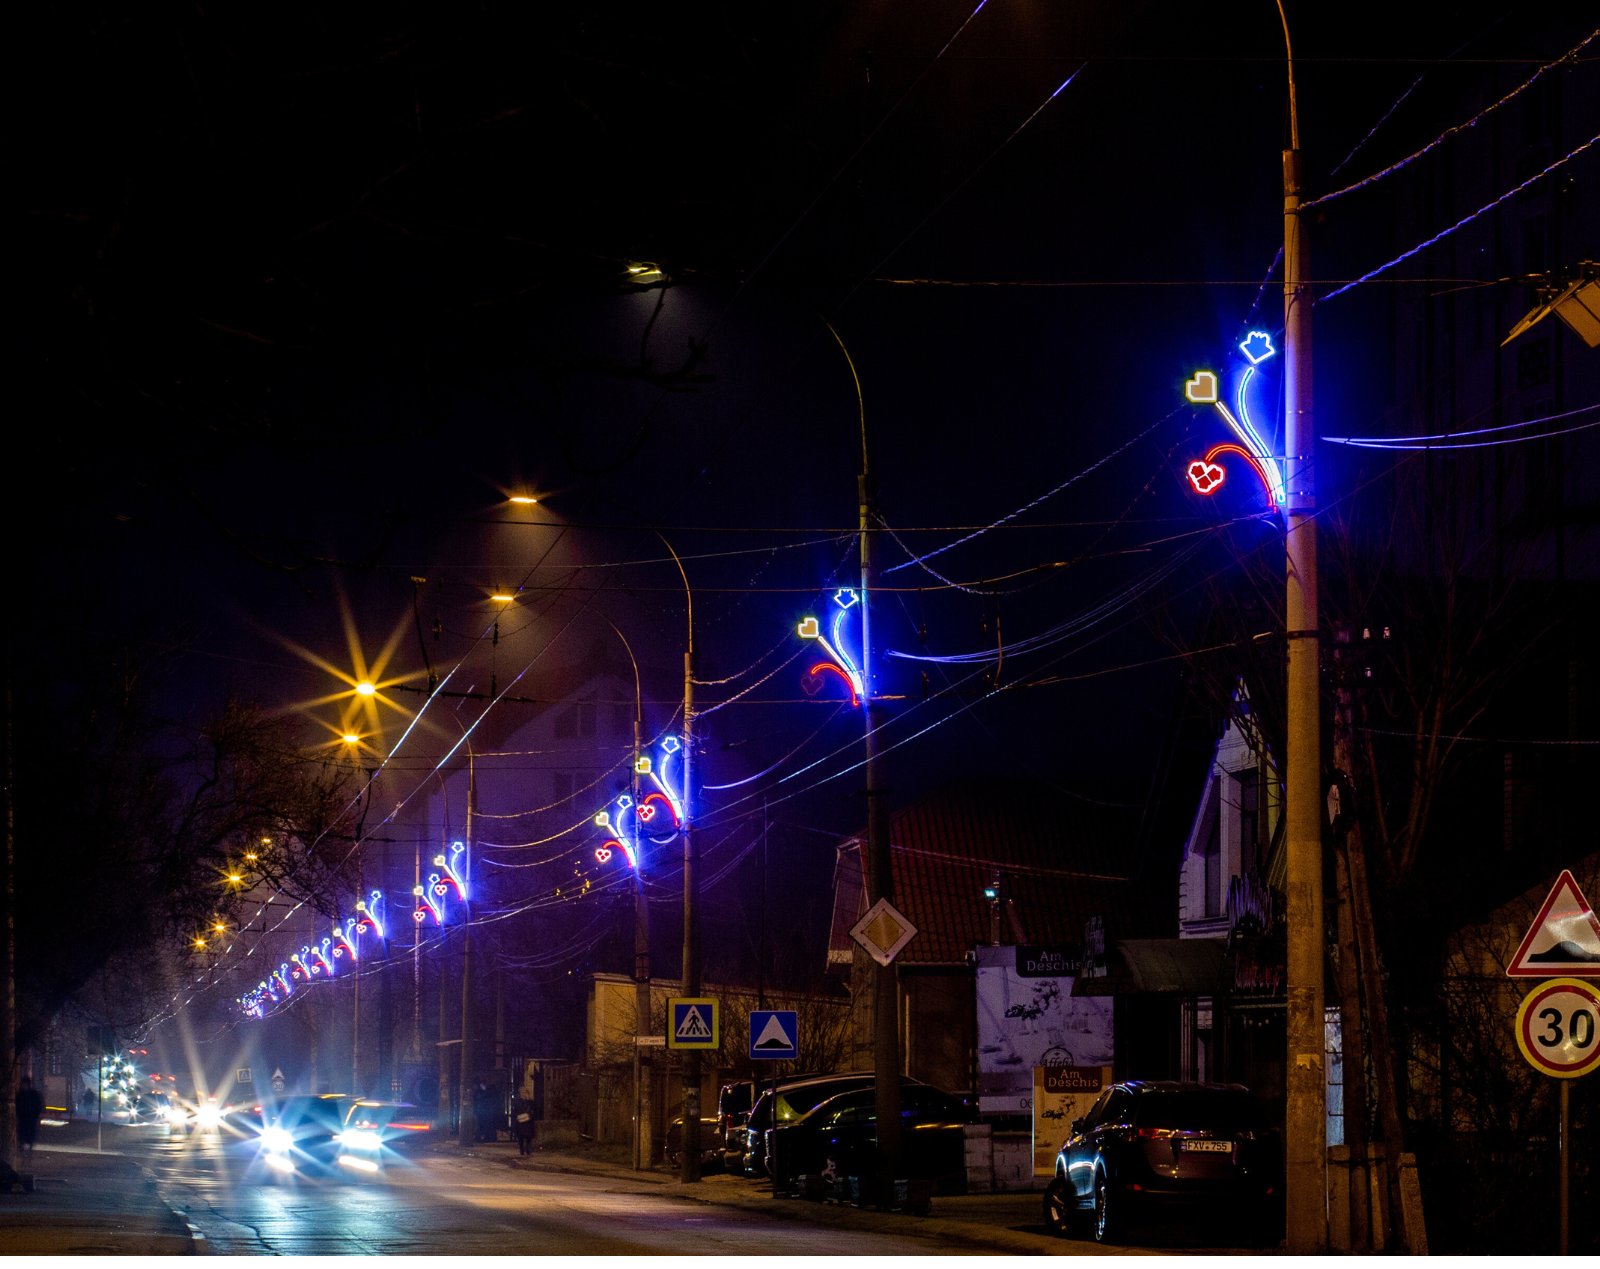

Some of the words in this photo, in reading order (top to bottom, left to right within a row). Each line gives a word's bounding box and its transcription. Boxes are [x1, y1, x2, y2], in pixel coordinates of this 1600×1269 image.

[1040, 951, 1062, 961] Am
[1027, 960, 1081, 971] Deschis
[1537, 1008, 1595, 1048] 30
[1060, 1069, 1080, 1079] Am
[1048, 1077, 1099, 1087] Deschis
